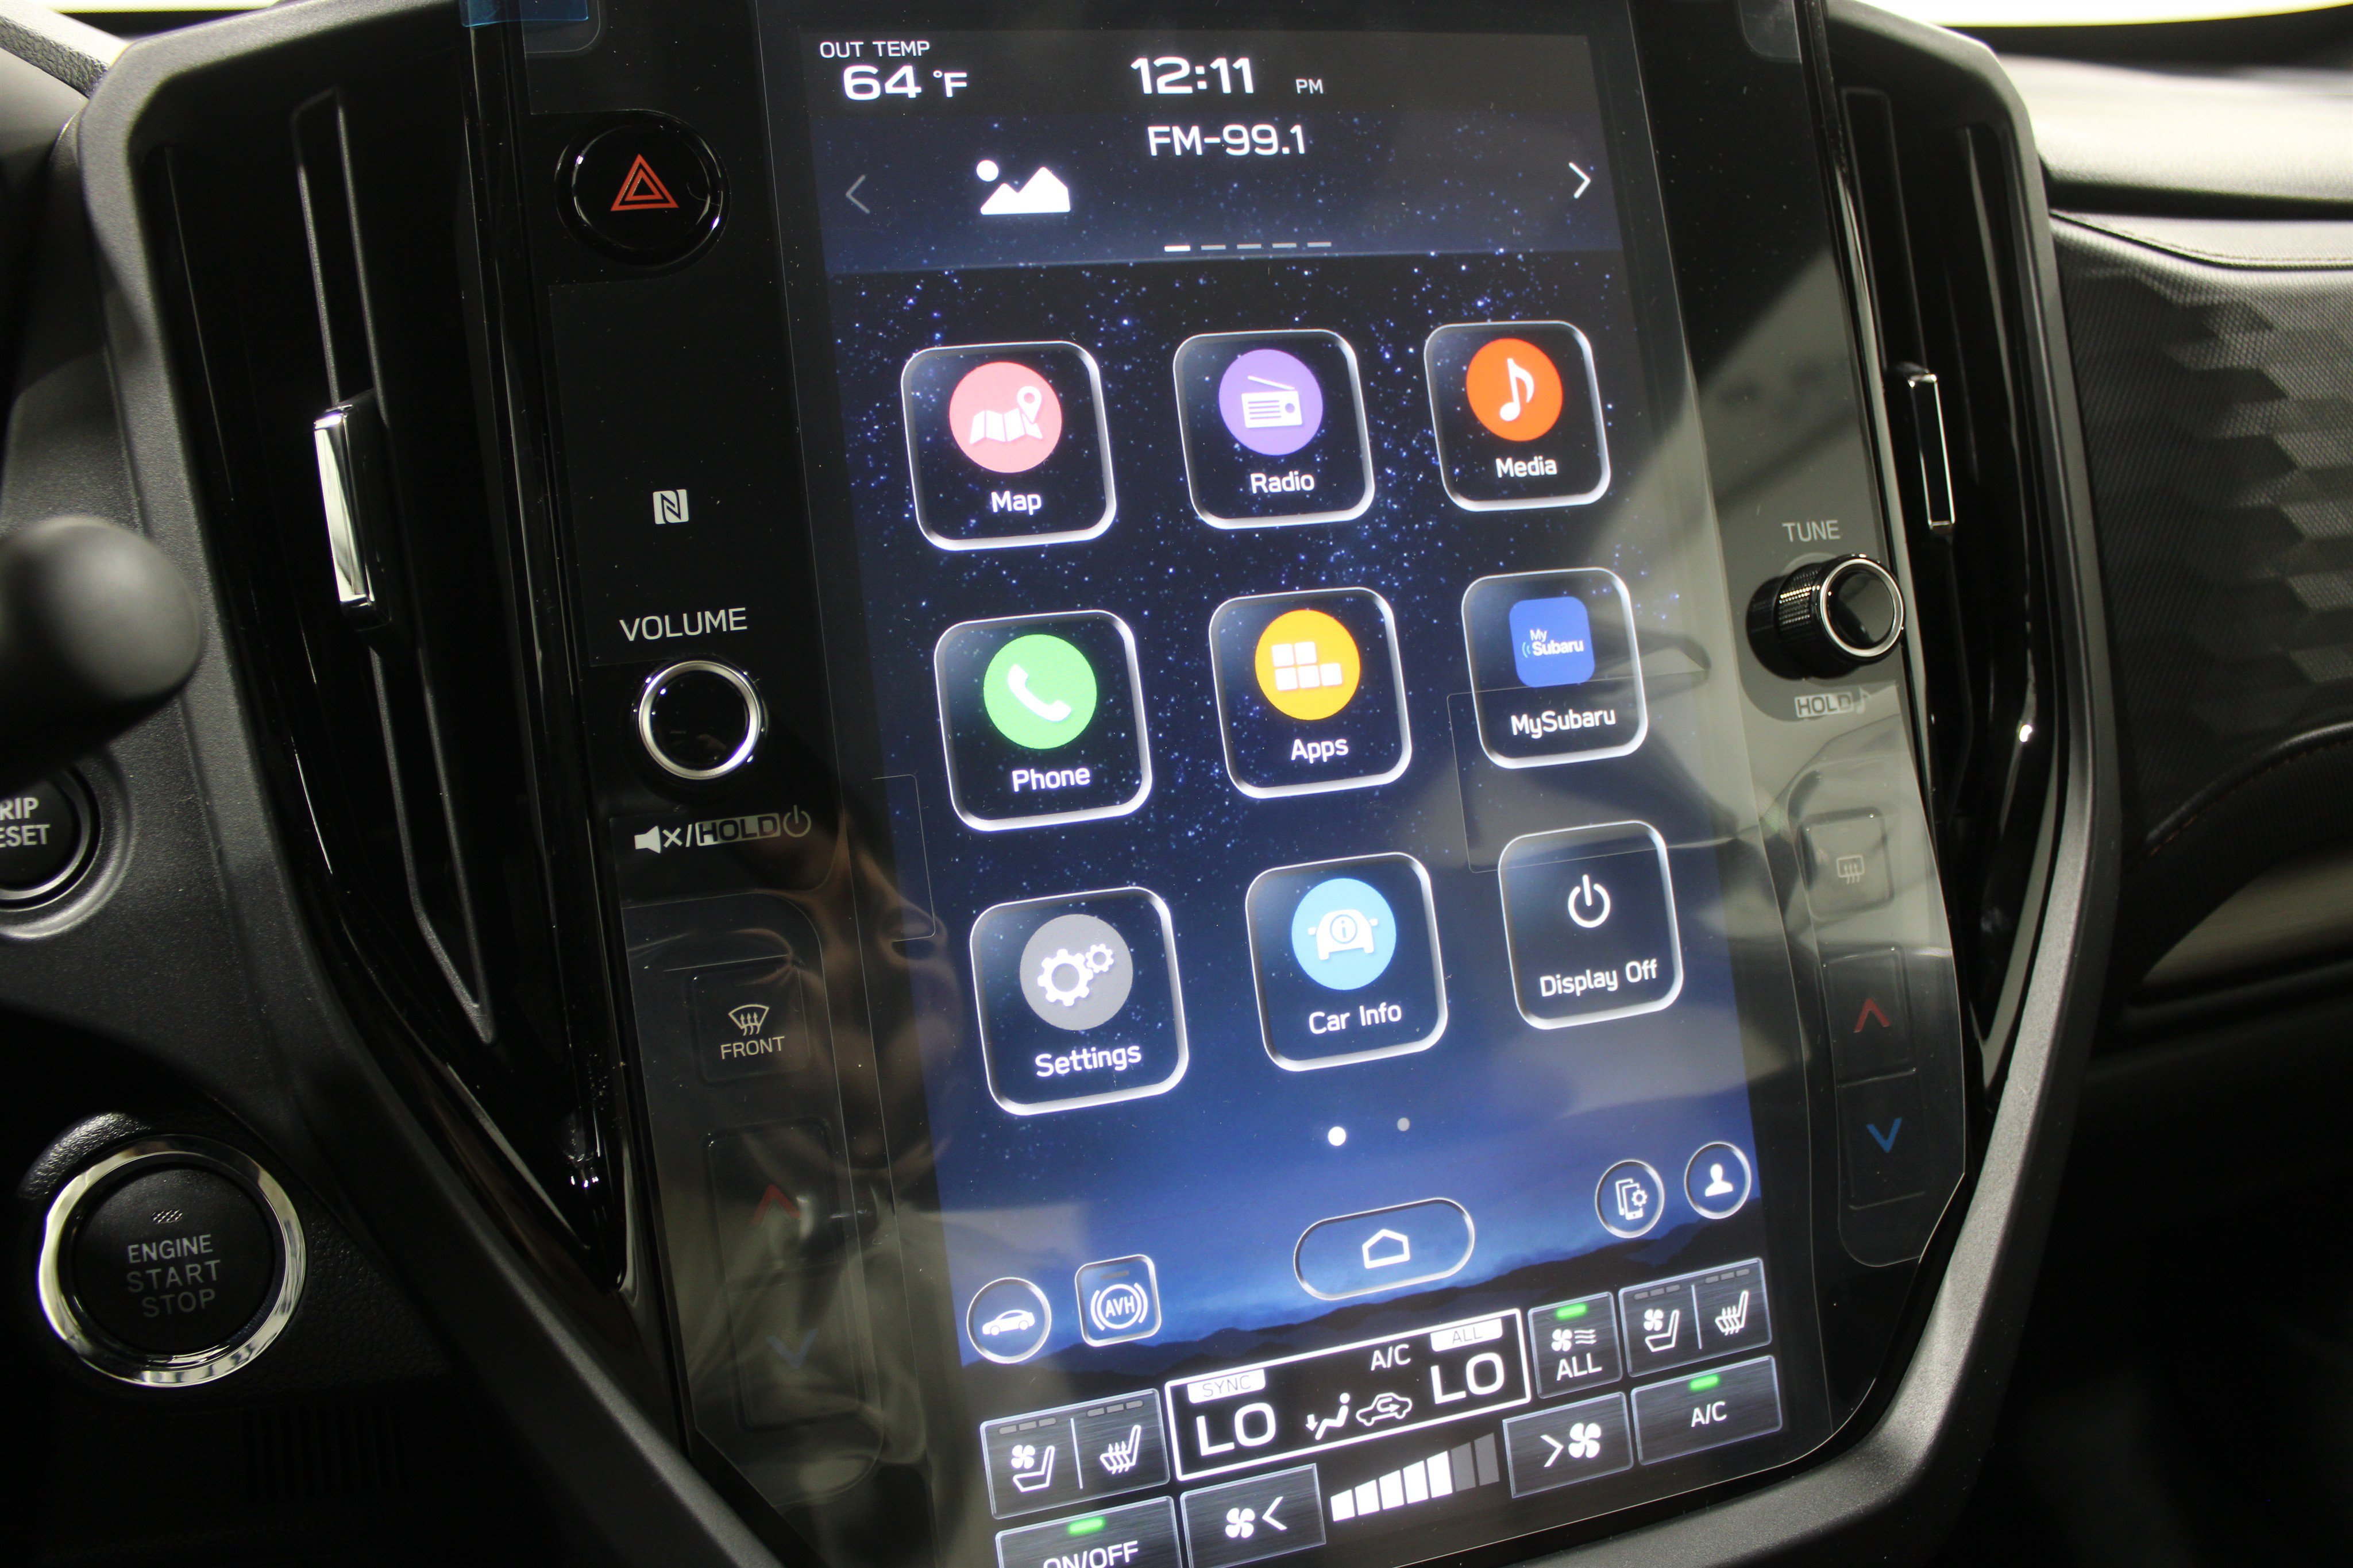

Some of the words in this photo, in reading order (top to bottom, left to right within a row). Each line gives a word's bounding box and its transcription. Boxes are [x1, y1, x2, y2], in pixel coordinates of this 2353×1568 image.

[820, 41, 864, 59] OUT
[872, 40, 930, 57] TEMP
[842, 64, 923, 101] 64
[1130, 56, 1255, 95] 12:11
[1295, 78, 1324, 95] PM
[1147, 123, 1306, 157] FM-99.1
[1495, 455, 1558, 478] Media
[1249, 470, 1316, 495] Radio
[990, 489, 1043, 516] Map
[1781, 519, 1841, 543] TUNE
[618, 607, 748, 642] VOLUME
[1529, 628, 1548, 643] My
[1532, 639, 1585, 656] Subaru
[1796, 693, 1851, 716] HOLD
[1510, 708, 1617, 740] MySubaru
[1290, 737, 1349, 764] Apps
[1011, 767, 1091, 793] Phone
[0, 797, 39, 821] RIP
[1539, 968, 1619, 998] Display
[1625, 957, 1658, 983] Off
[1308, 1010, 1351, 1035] Car
[1359, 1001, 1403, 1027] Info
[720, 1036, 785, 1060] FRONT
[1034, 1044, 1143, 1078] Settings
[128, 1234, 213, 1264] ENGINE
[126, 1260, 221, 1293] START
[141, 1288, 216, 1318] STOP
[1105, 1295, 1136, 1318] AVH
[1452, 1326, 1483, 1345] ALL
[1370, 1343, 1411, 1372] A/C
[1556, 1353, 1603, 1382] ALL
[1202, 1374, 1252, 1397] SYNC
[1430, 1352, 1505, 1405] LO
[1690, 1400, 1728, 1428] A/C
[1195, 1402, 1277, 1457] LO
